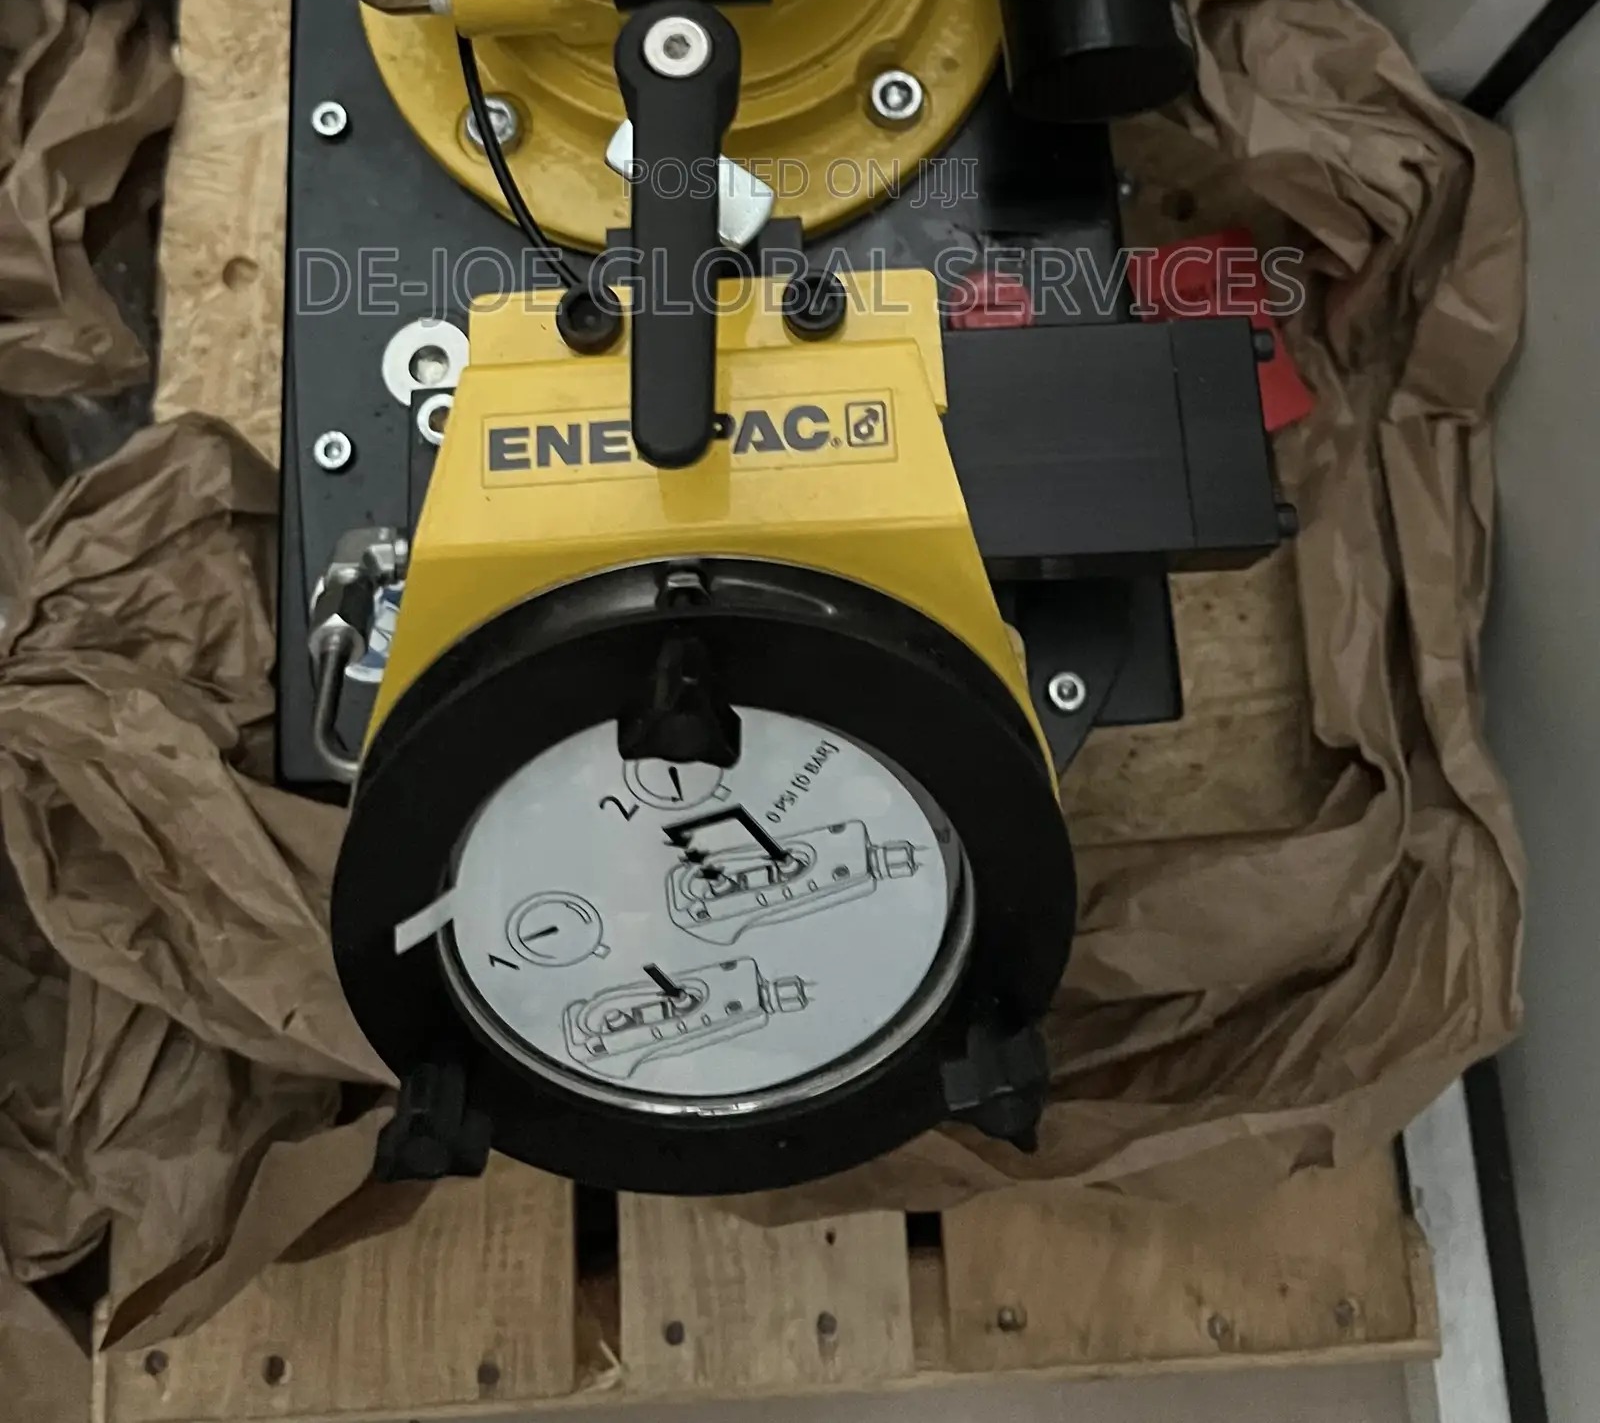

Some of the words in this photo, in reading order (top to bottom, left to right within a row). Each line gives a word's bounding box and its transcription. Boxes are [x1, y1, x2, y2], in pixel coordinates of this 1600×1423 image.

[488, 405, 829, 471] ENEAC
[599, 795, 640, 821] 2
[488, 953, 520, 970] 1
